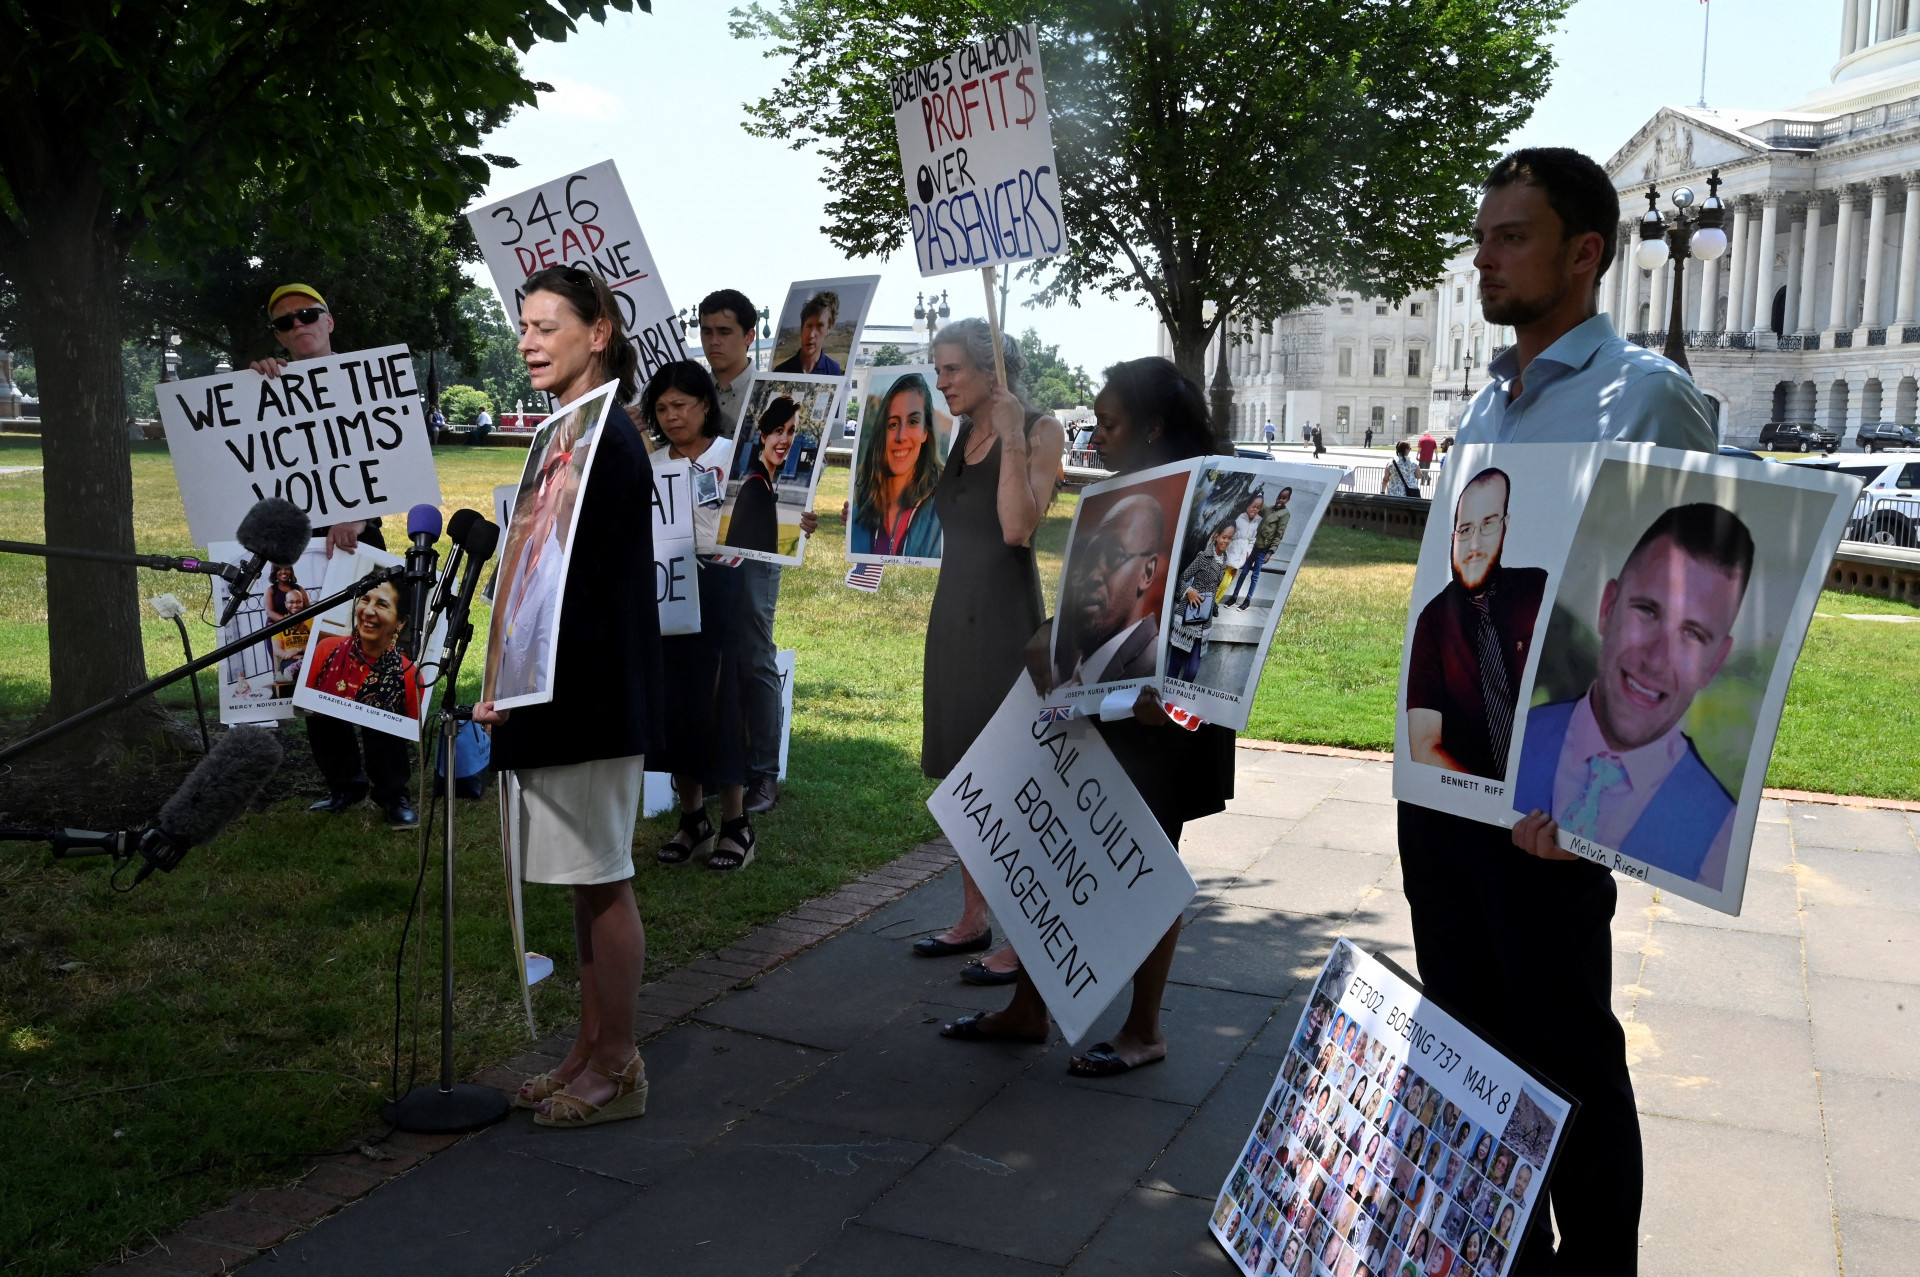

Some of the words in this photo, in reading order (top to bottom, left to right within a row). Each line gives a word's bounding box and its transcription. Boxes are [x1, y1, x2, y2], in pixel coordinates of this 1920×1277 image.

[890, 60, 952, 111] BOEING'S
[958, 25, 1031, 80] CALHOUN
[921, 60, 1036, 152] PROFIT$
[917, 148, 975, 204] OVER
[491, 175, 599, 247] 346
[910, 166, 1062, 272] PASSENGERS
[514, 224, 605, 277] DEAD
[176, 383, 240, 431] WE
[257, 367, 336, 421] ARE
[340, 353, 418, 400] THE
[225, 405, 409, 472] VICTIMS'
[318, 694, 352, 708] GRAZIELLA
[366, 708, 380, 716] LUIS
[383, 713, 403, 723] PONCE
[1065, 691, 1085, 699] JOSEPH
[1088, 687, 1105, 696] KURIA
[1176, 690, 1196, 701] PAULS
[1189, 684, 1206, 694] RYAN
[1031, 720, 1080, 788] JAIL
[1076, 778, 1154, 889] GUILTY
[1441, 775, 1479, 791] BENNETT
[1014, 777, 1098, 906] BOEING
[1570, 837, 1607, 864] Melvin
[1613, 853, 1649, 880] Riffel
[952, 772, 1098, 999] MANAGEMENT
[1348, 976, 1385, 1015] ET302
[1386, 1006, 1436, 1056] BOEING
[1432, 1042, 1462, 1074] 737
[1463, 1064, 1499, 1106] MAX
[1496, 1092, 1511, 1116] 8
